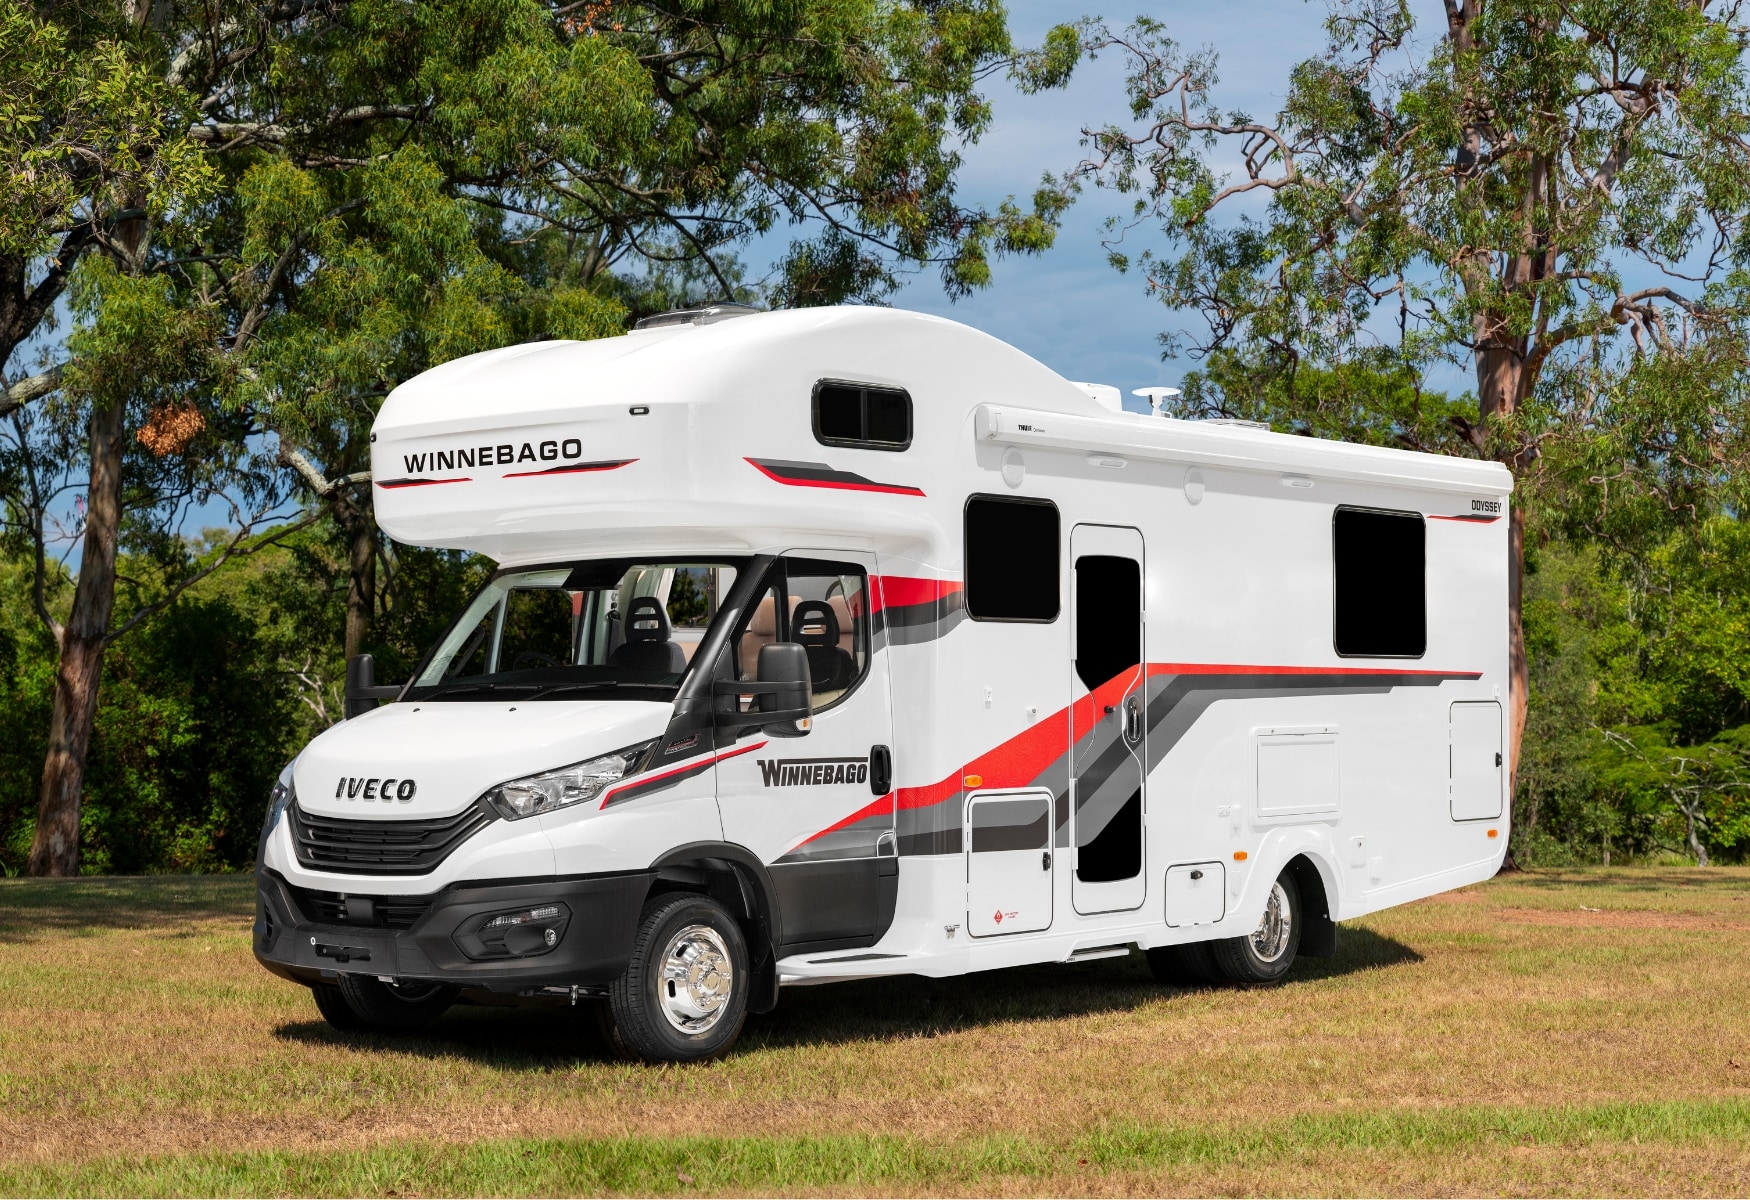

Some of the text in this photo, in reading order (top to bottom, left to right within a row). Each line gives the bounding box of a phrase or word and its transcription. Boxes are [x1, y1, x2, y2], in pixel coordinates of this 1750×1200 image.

[404, 438, 582, 474] WINNEBAGO
[1471, 499, 1502, 513] ODYSSEY
[756, 756, 869, 788] WINNEBAGO
[335, 777, 417, 804] IVECO
